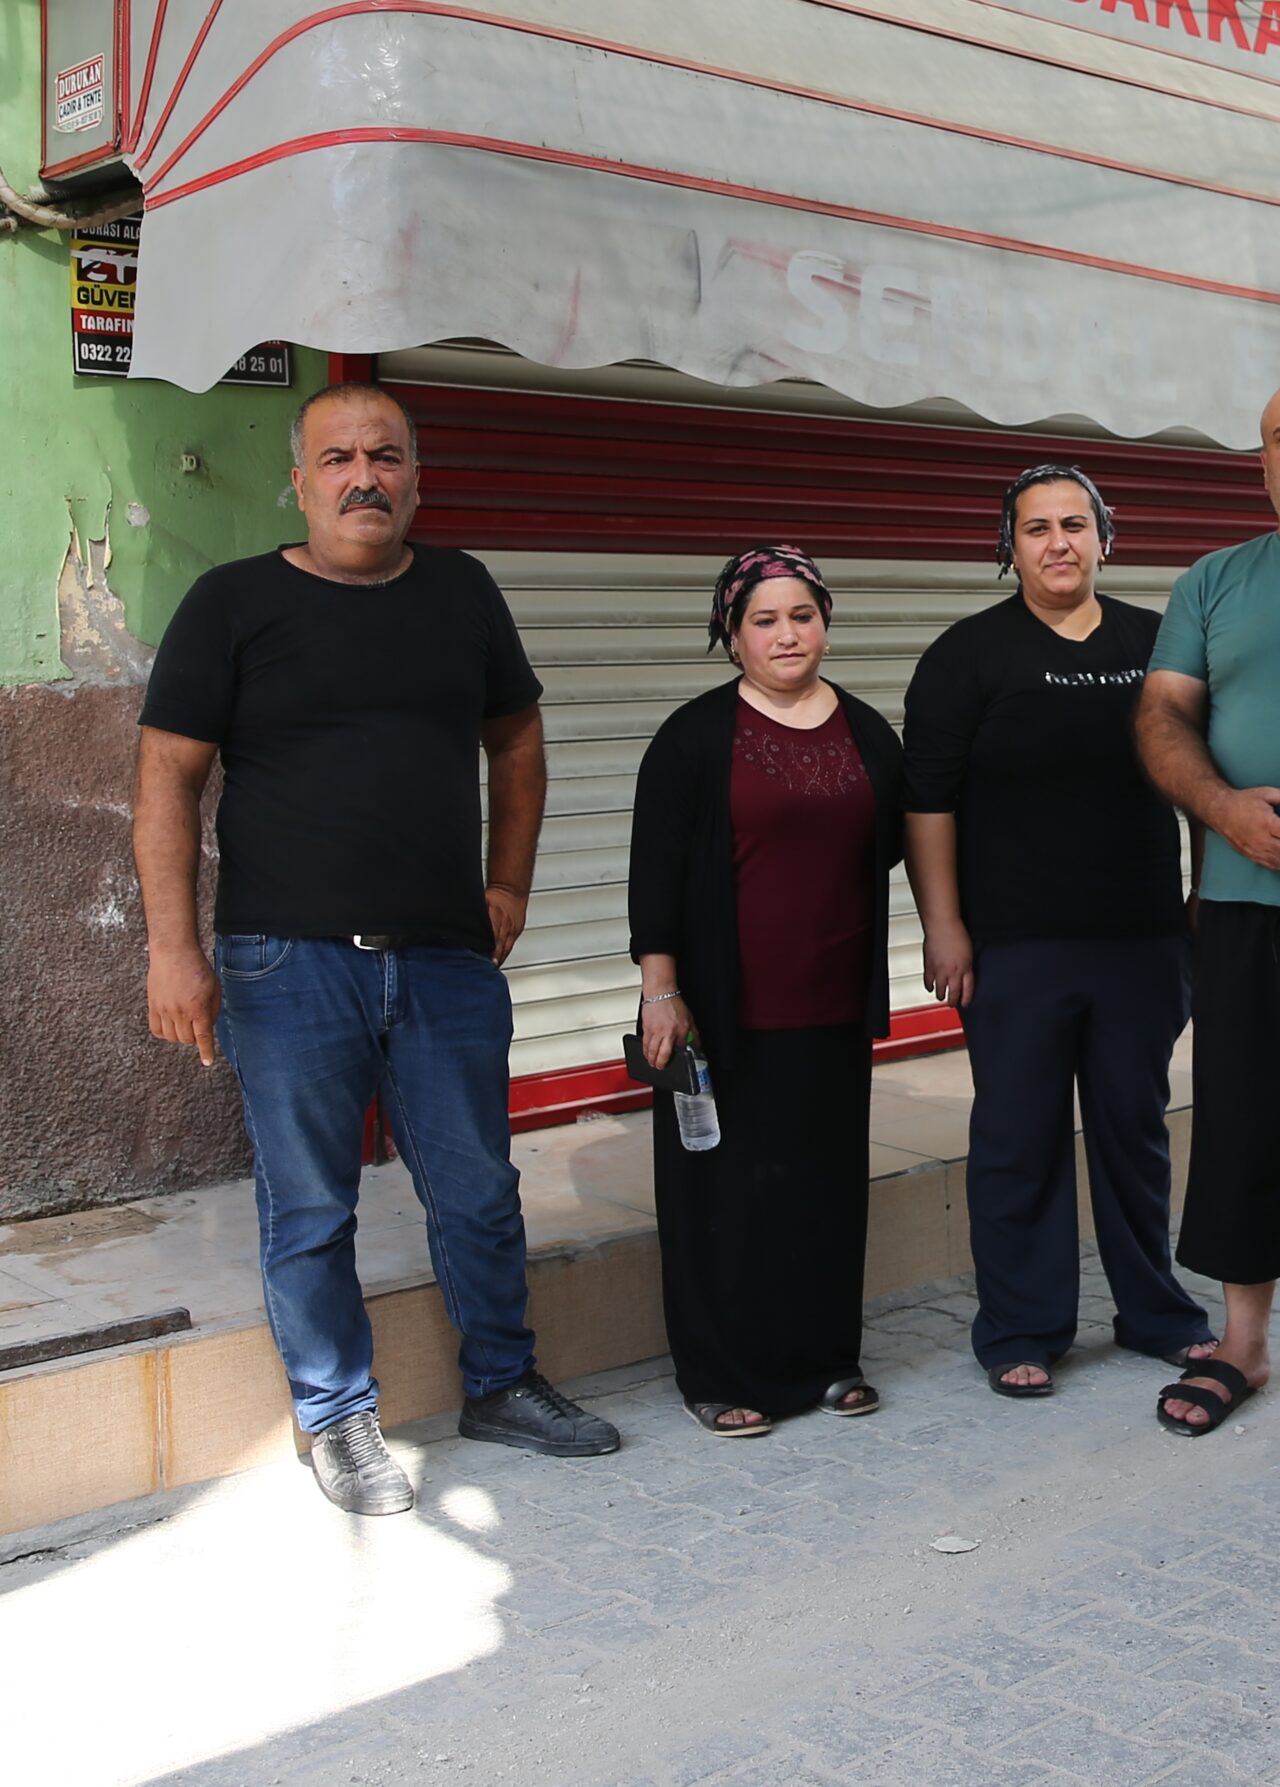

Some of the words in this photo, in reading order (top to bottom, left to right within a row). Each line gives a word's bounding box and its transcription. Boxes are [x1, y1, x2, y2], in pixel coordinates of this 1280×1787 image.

[59, 62, 102, 98] DURUKAN
[83, 89, 102, 109] TENTE
[80, 343, 112, 362] 0322
[250, 356, 265, 372] 25
[269, 357, 283, 373] 01
